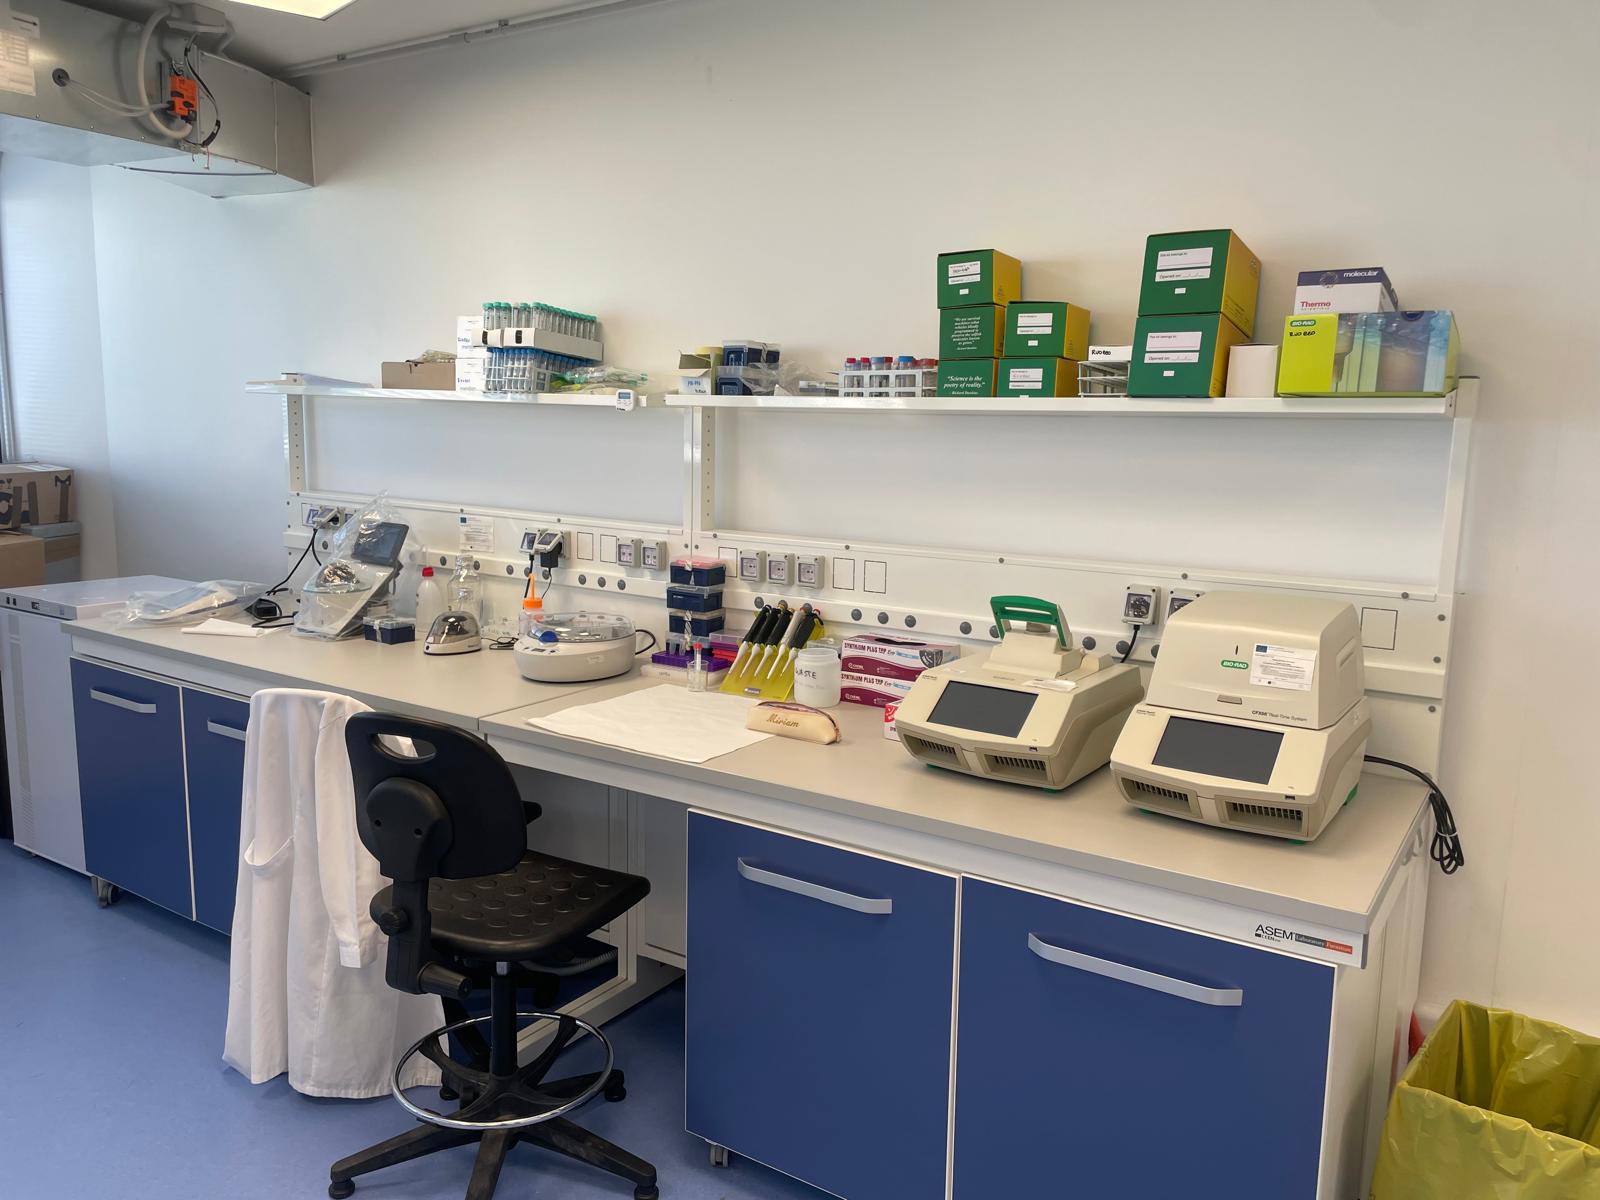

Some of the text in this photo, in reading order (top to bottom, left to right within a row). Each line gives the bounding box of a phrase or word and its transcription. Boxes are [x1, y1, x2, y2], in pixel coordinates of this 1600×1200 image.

[1343, 269, 1379, 278] molecular
[866, 645, 878, 653] PLUS
[1222, 661, 1248, 669] BIO-RAD
[863, 676, 875, 684] PLUS
[766, 713, 801, 728] Miriam
[1255, 924, 1293, 941] ASEM
